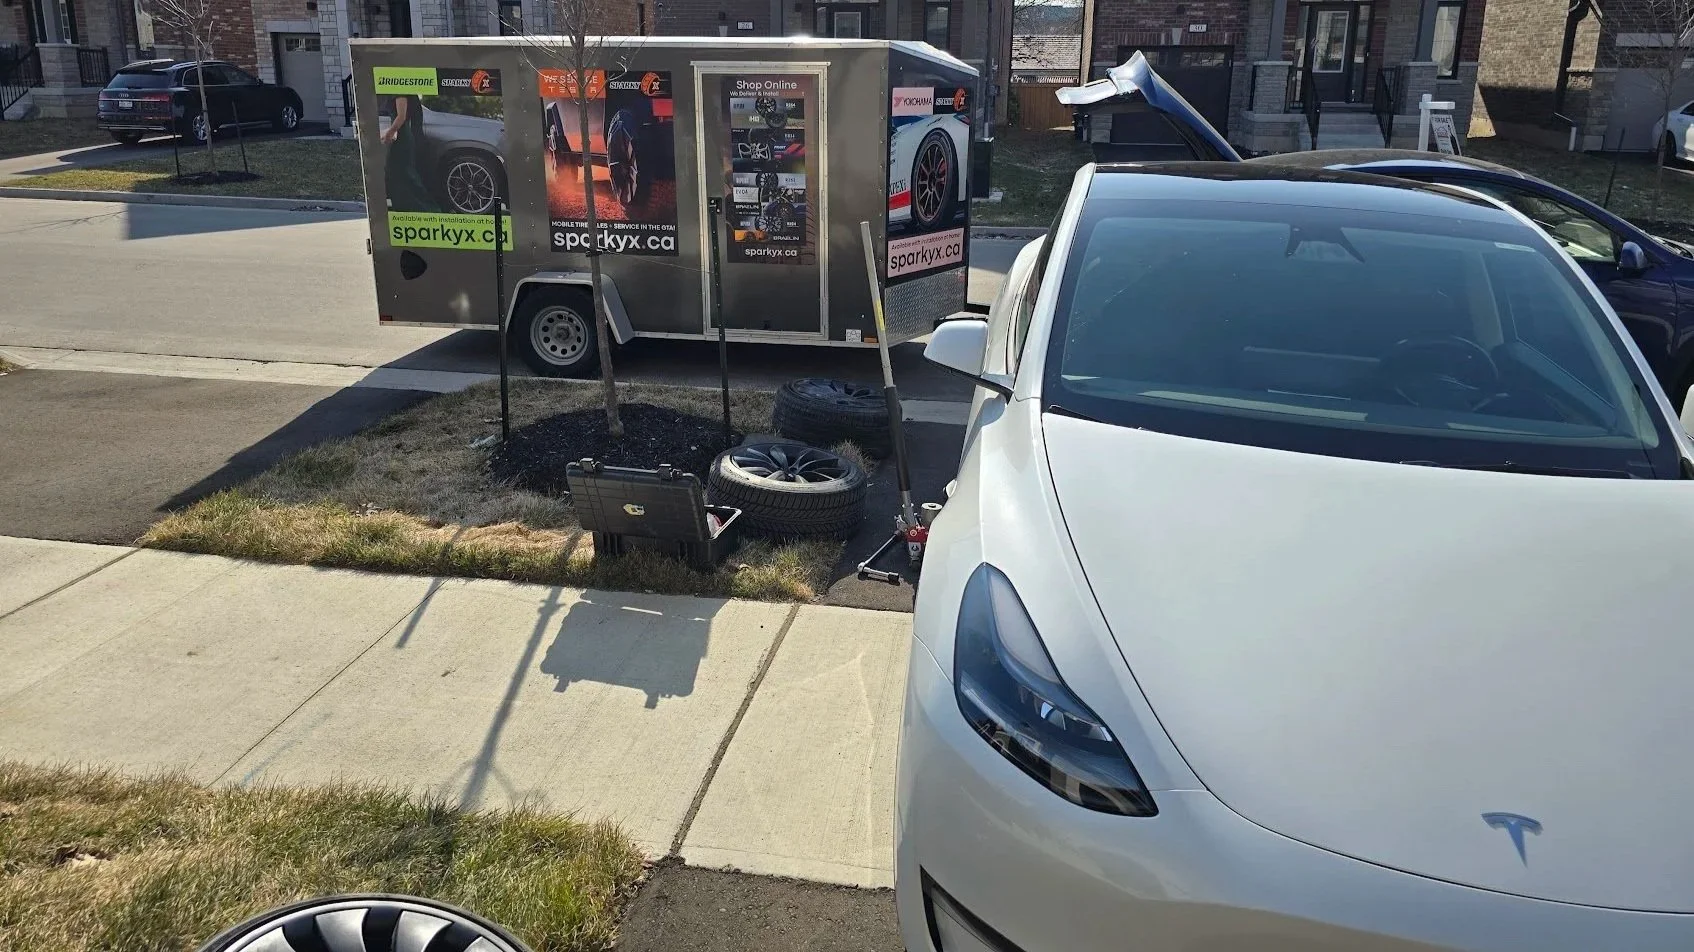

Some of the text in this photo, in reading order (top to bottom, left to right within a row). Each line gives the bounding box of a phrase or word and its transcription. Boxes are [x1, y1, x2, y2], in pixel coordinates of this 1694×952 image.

[378, 76, 434, 87] BRIDGESTONE
[441, 79, 471, 87] SPARKY
[609, 81, 641, 90] SPARKY
[736, 80, 797, 91] Shop Online
[903, 97, 932, 106] YOKOHAMA
[439, 216, 475, 224] installation
[890, 243, 961, 272] sparkyx.ca
